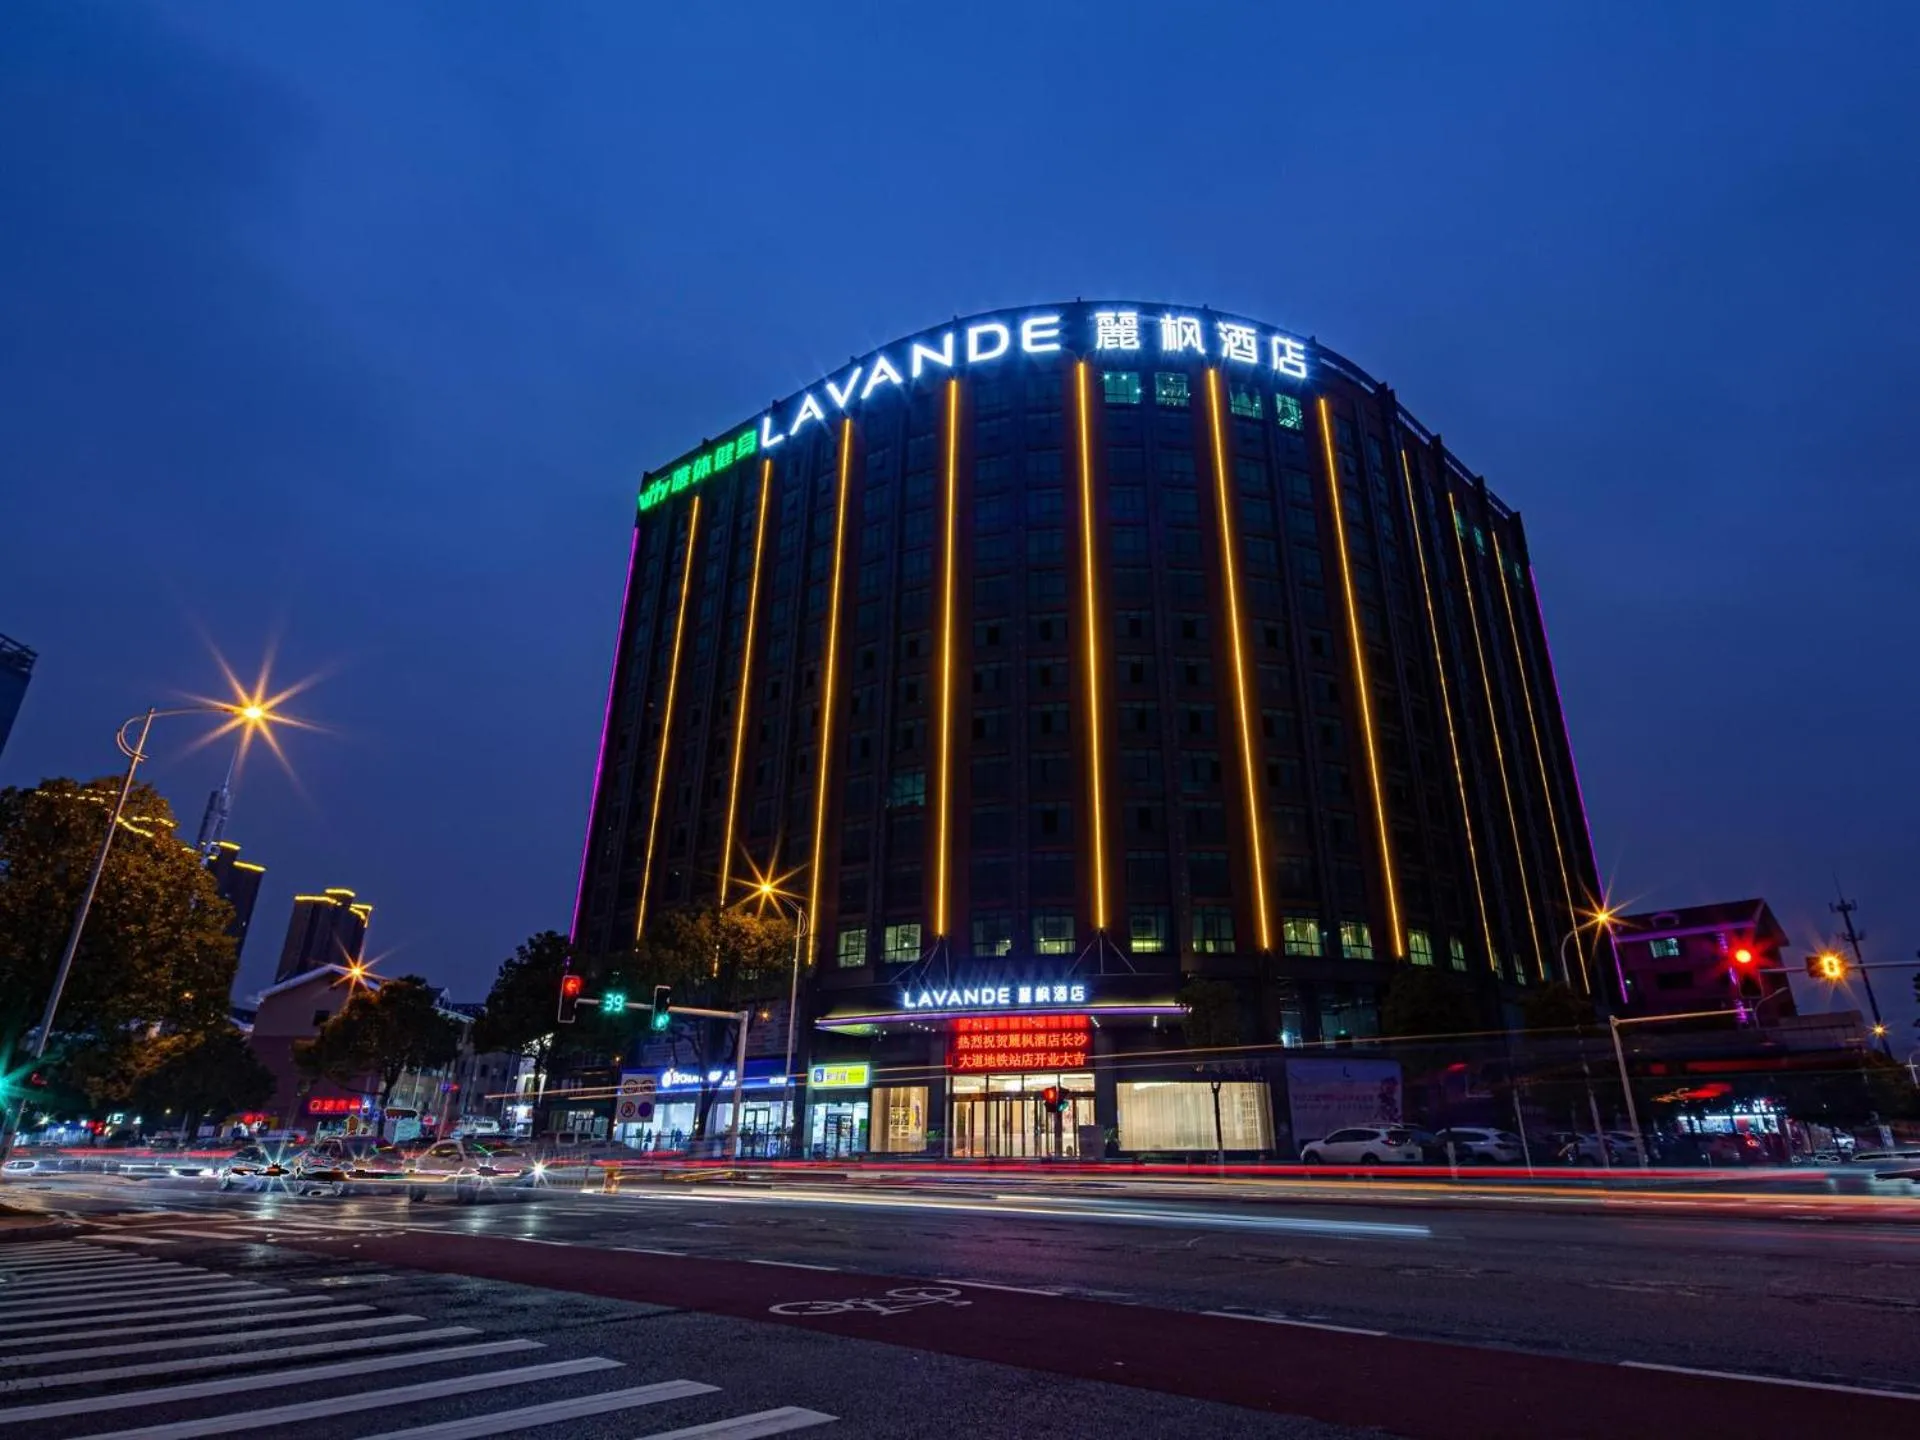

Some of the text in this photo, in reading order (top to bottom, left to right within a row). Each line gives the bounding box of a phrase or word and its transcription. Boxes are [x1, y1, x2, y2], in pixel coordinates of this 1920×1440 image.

[761, 312, 1307, 447] LAVANDE 麗枫酒店
[604, 993, 624, 1012] 39
[904, 987, 1010, 1008] LAVANDE
[958, 1052, 1086, 1068] 大道地铁站店开业大吉
